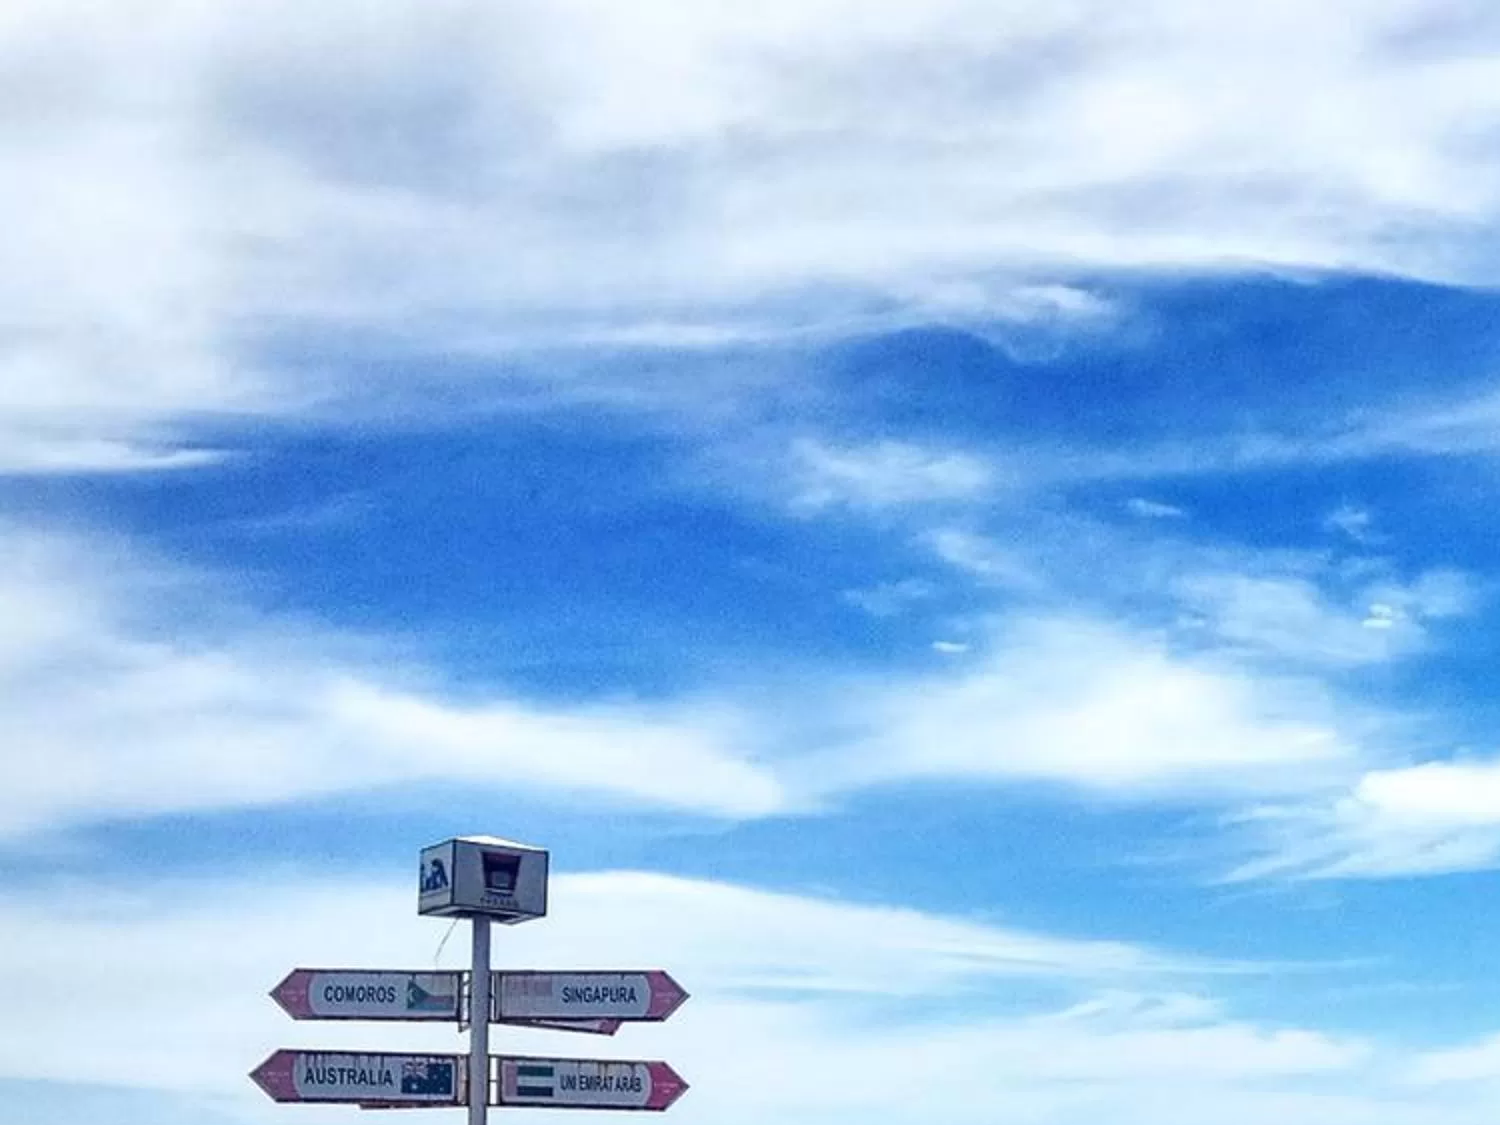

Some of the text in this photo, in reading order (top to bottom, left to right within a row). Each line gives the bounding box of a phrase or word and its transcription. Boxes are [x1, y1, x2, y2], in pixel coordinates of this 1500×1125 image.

[323, 985, 397, 1003] COMOROS
[561, 986, 637, 1004] SINGAPURA
[303, 1066, 394, 1086] AUSTRALIA
[614, 1076, 642, 1093] ARAB
